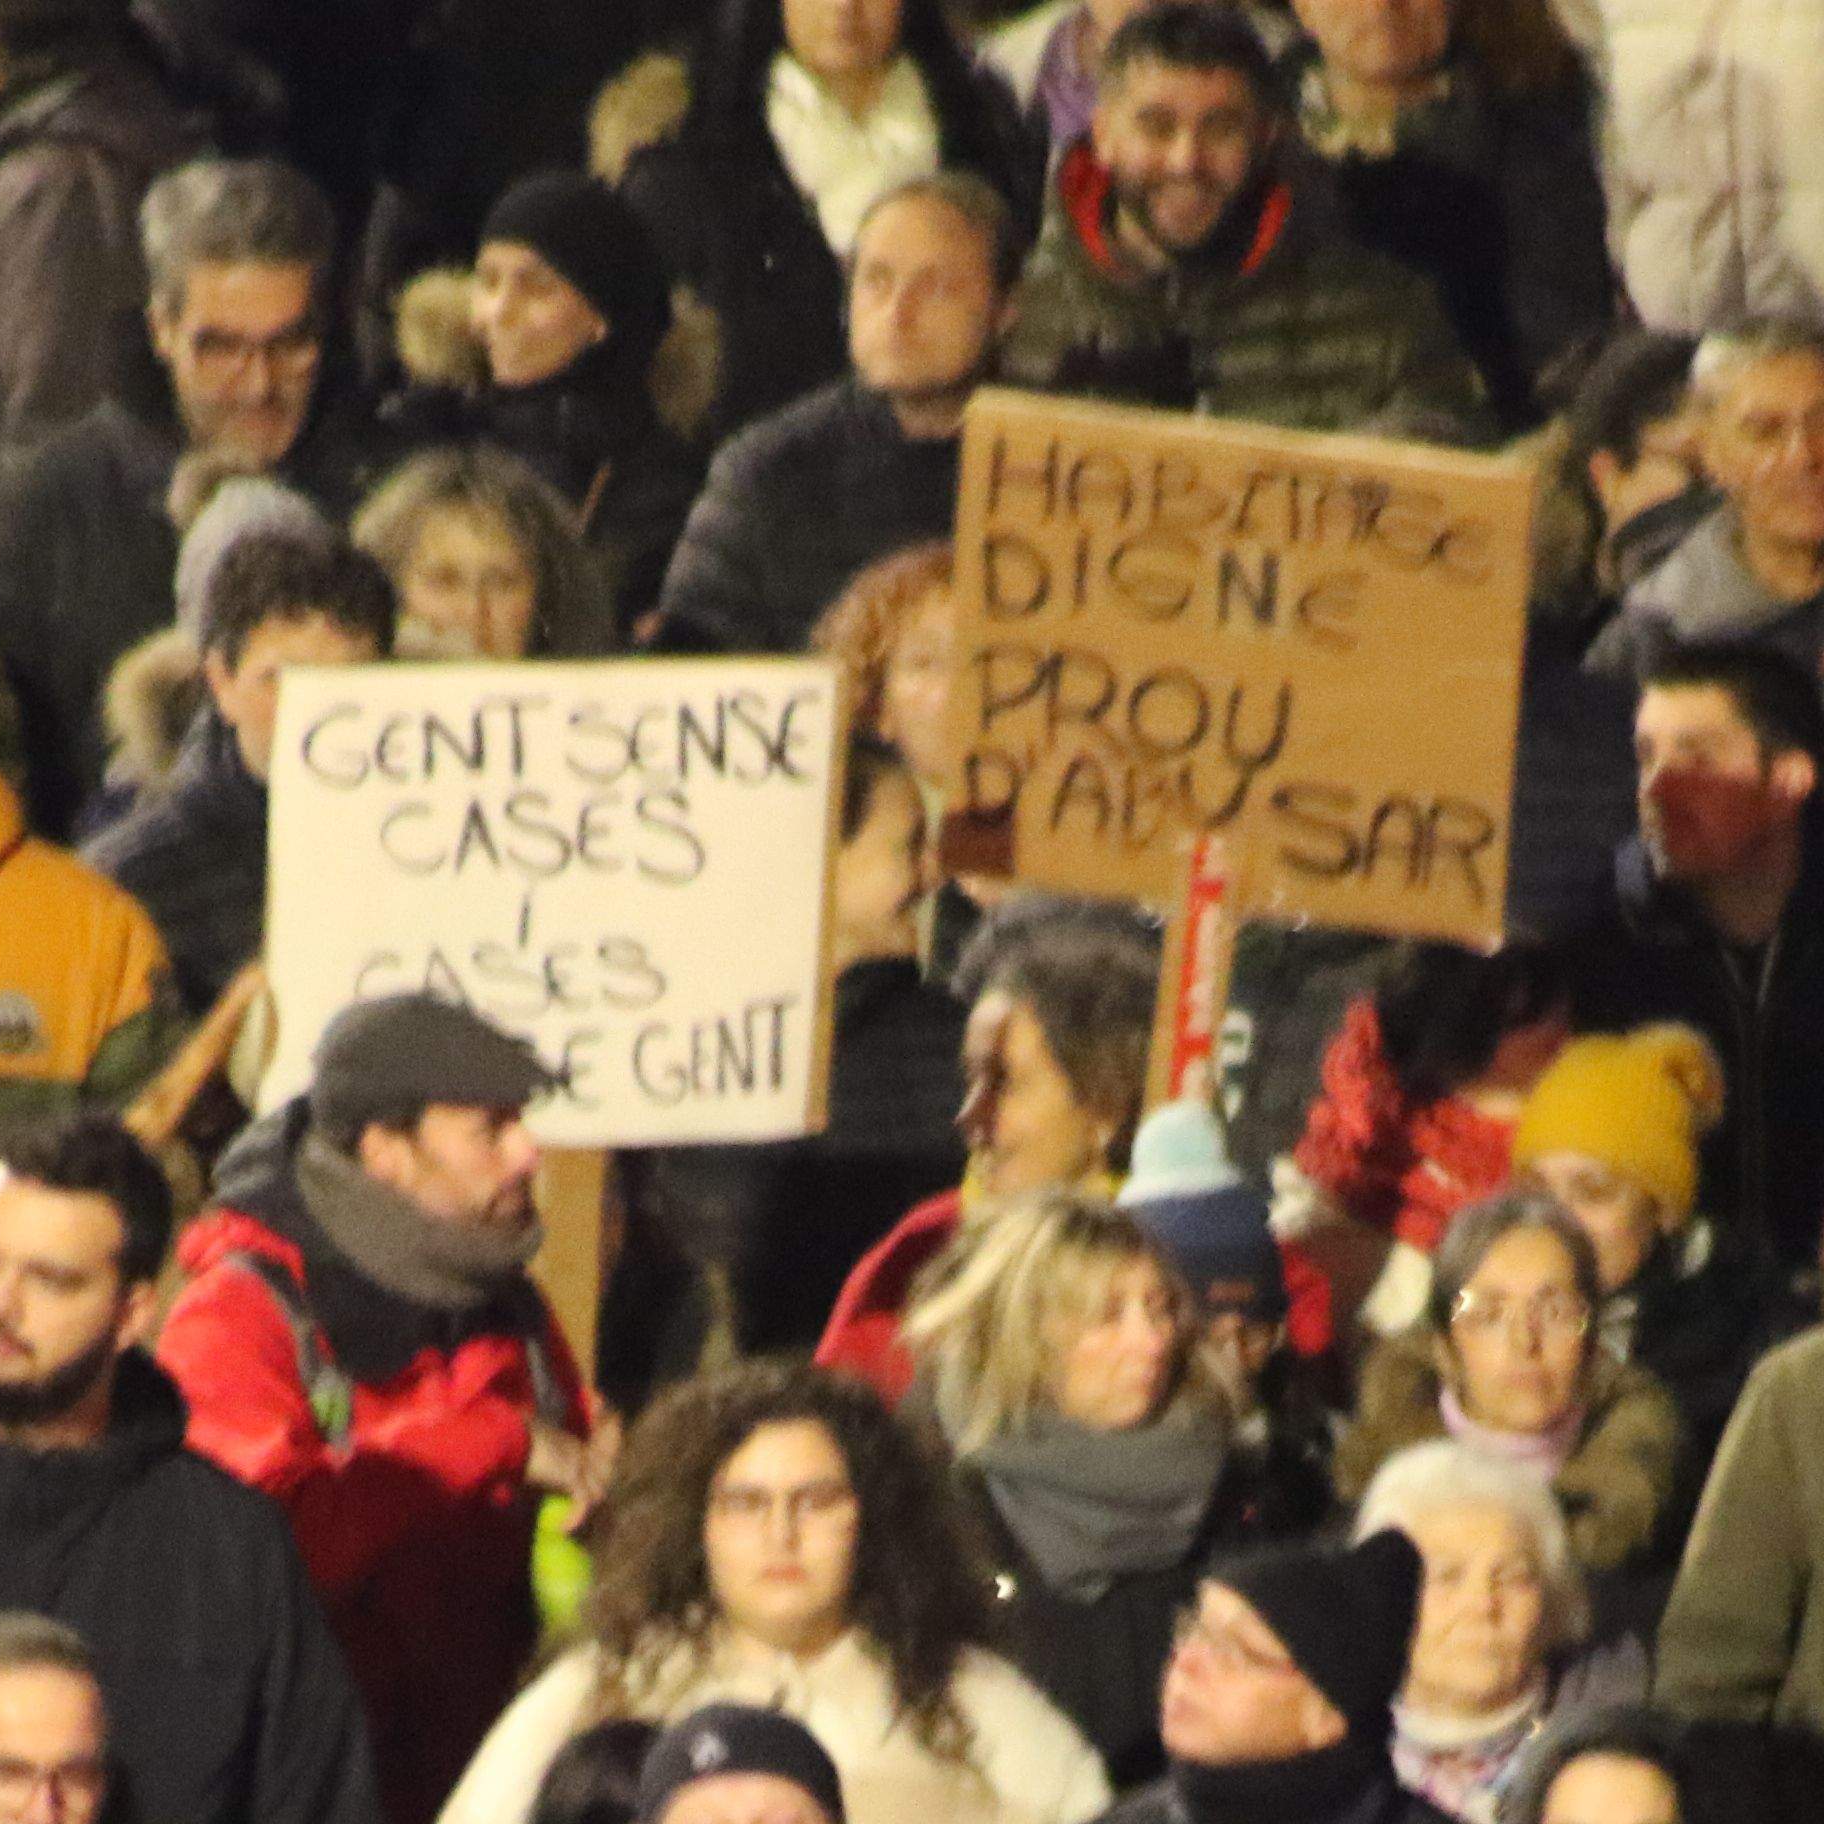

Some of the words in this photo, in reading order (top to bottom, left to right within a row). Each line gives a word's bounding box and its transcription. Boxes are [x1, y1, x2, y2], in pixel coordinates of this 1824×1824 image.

[982, 531, 1370, 652] DIGNE
[301, 697, 550, 790] GENT
[567, 693, 821, 785] SENSE
[974, 641, 1293, 768] PROU
[380, 789, 707, 884] CASES
[528, 1028, 604, 1110] E
[632, 993, 801, 1105] GENT
